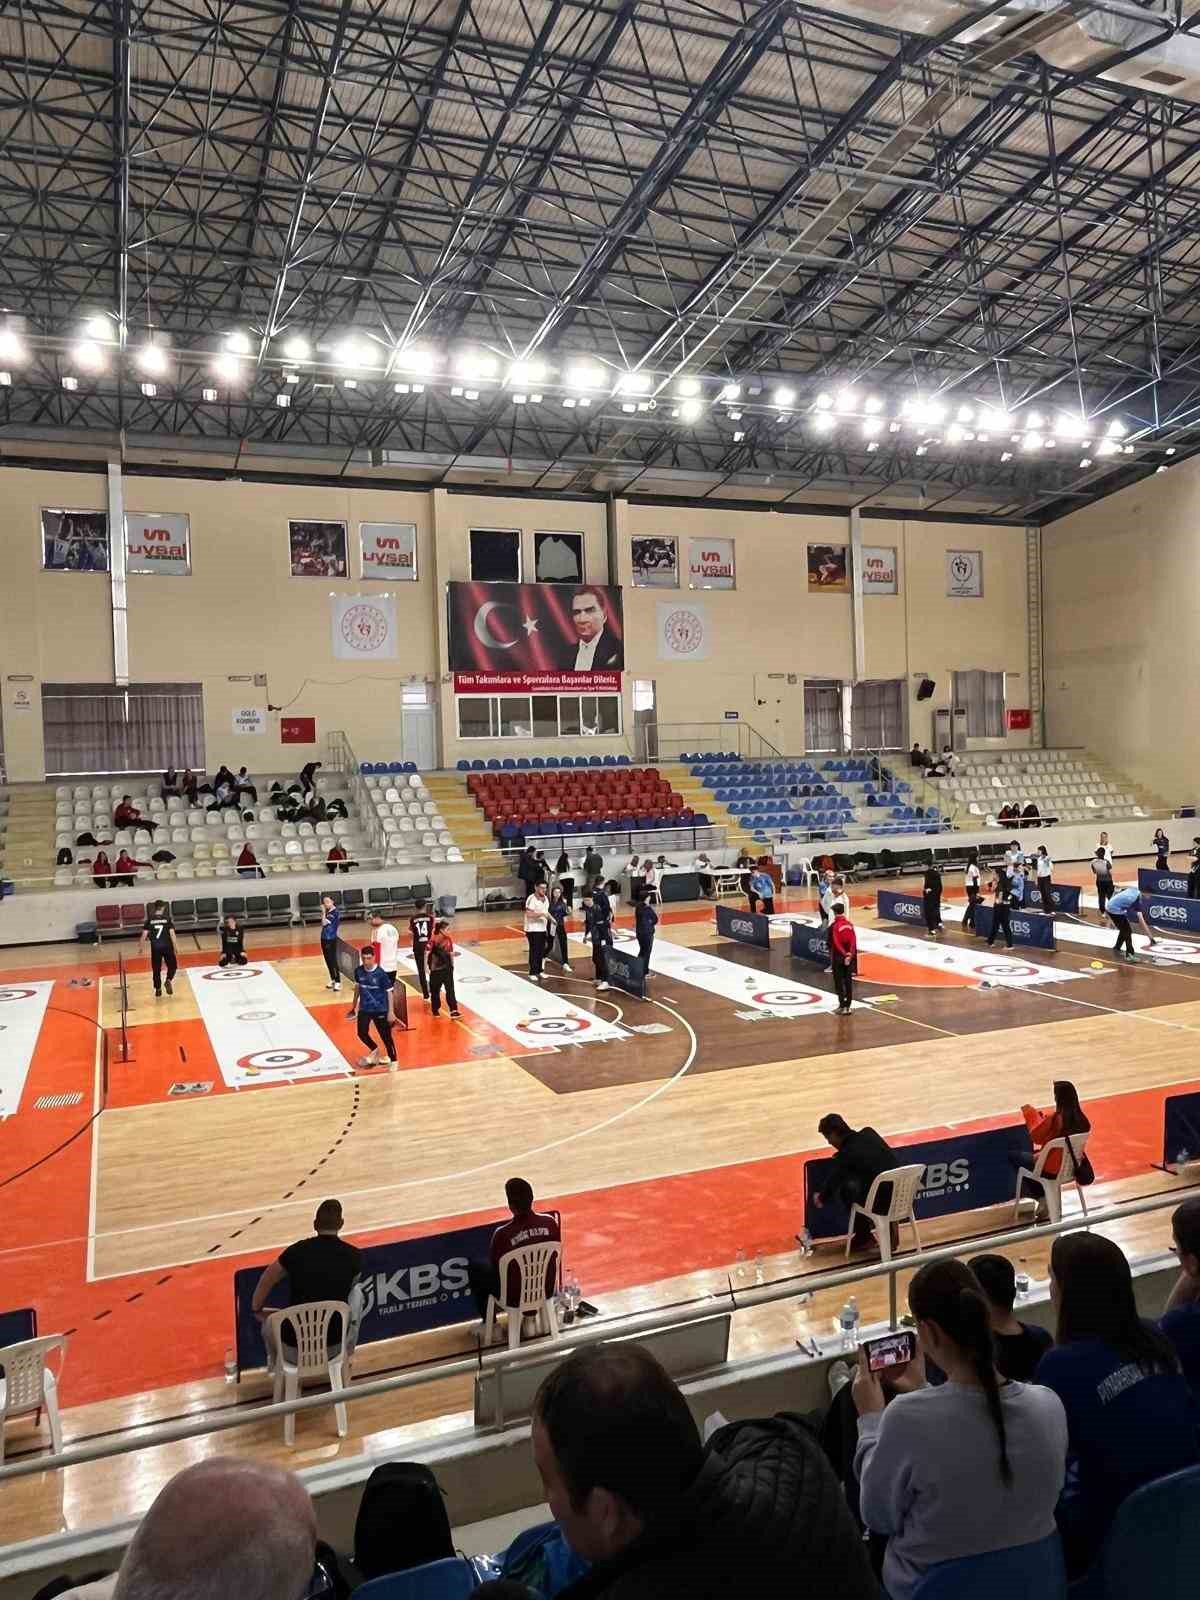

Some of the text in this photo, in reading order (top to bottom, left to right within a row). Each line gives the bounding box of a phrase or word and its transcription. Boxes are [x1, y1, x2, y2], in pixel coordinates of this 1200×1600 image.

[458, 675, 474, 684] Tüm
[1167, 880, 1188, 890] KBS
[902, 903, 920, 915] KBS
[1160, 906, 1187, 919] KBS
[154, 925, 163, 939] 7
[415, 921, 428, 936] 14
[376, 1257, 470, 1306] KBS
[379, 1302, 404, 1315] TABLE
